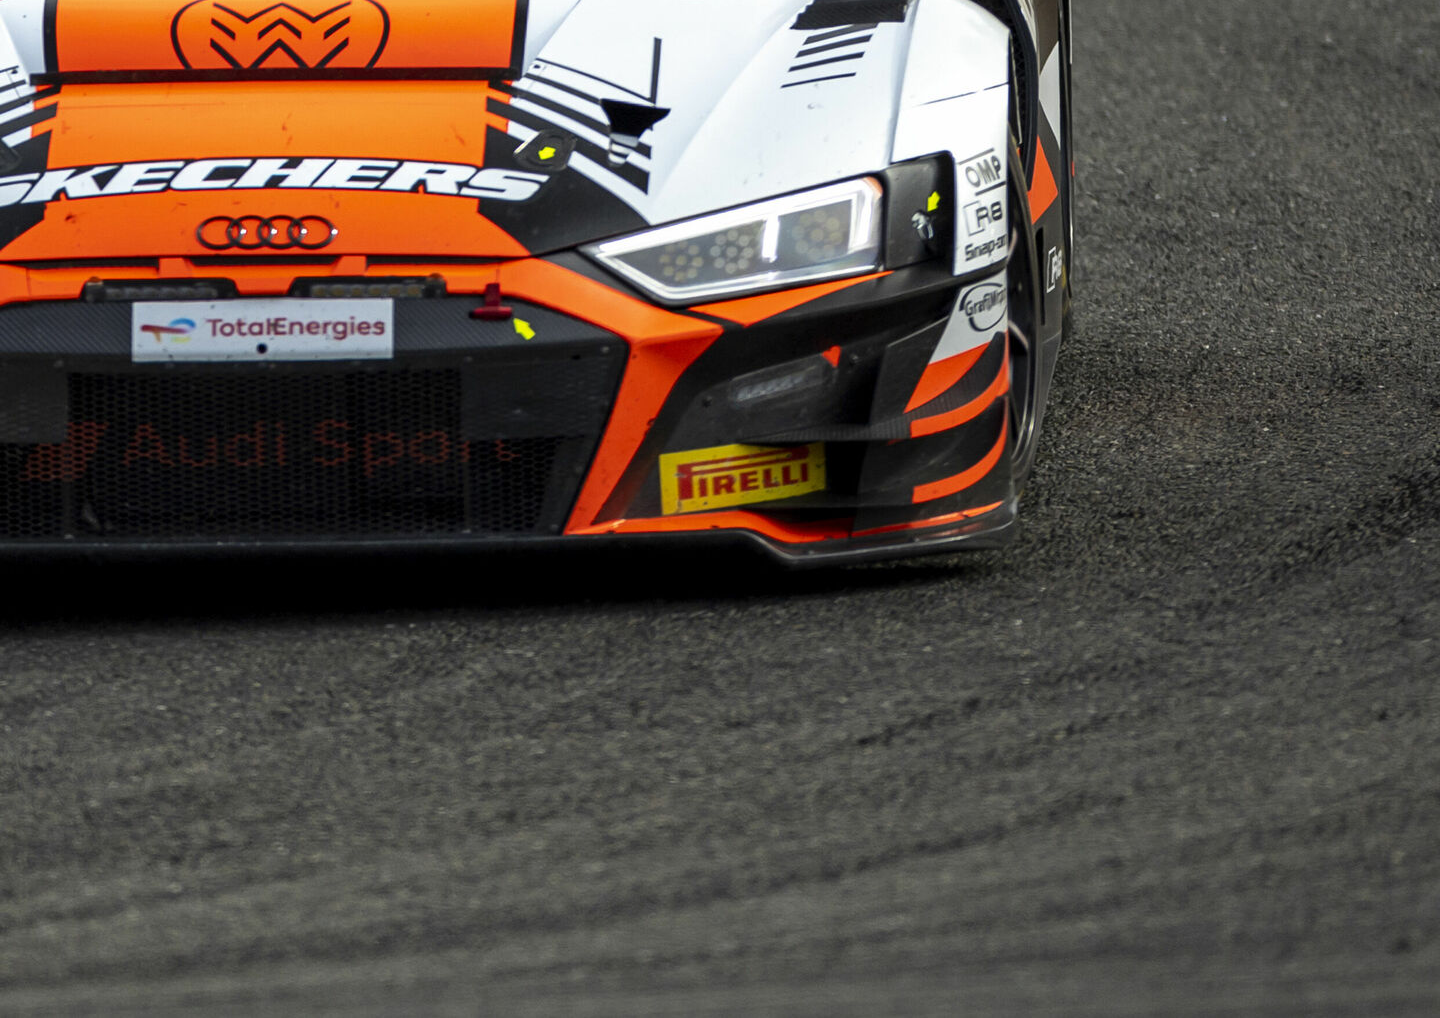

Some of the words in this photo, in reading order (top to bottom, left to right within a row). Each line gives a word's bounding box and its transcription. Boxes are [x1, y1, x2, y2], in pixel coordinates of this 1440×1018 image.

[965, 155, 1002, 188] OMP
[975, 200, 1003, 228] R8
[204, 315, 386, 341] TotalEnergies
[123, 420, 289, 468] Audi
[676, 444, 810, 501] PIRELLI
